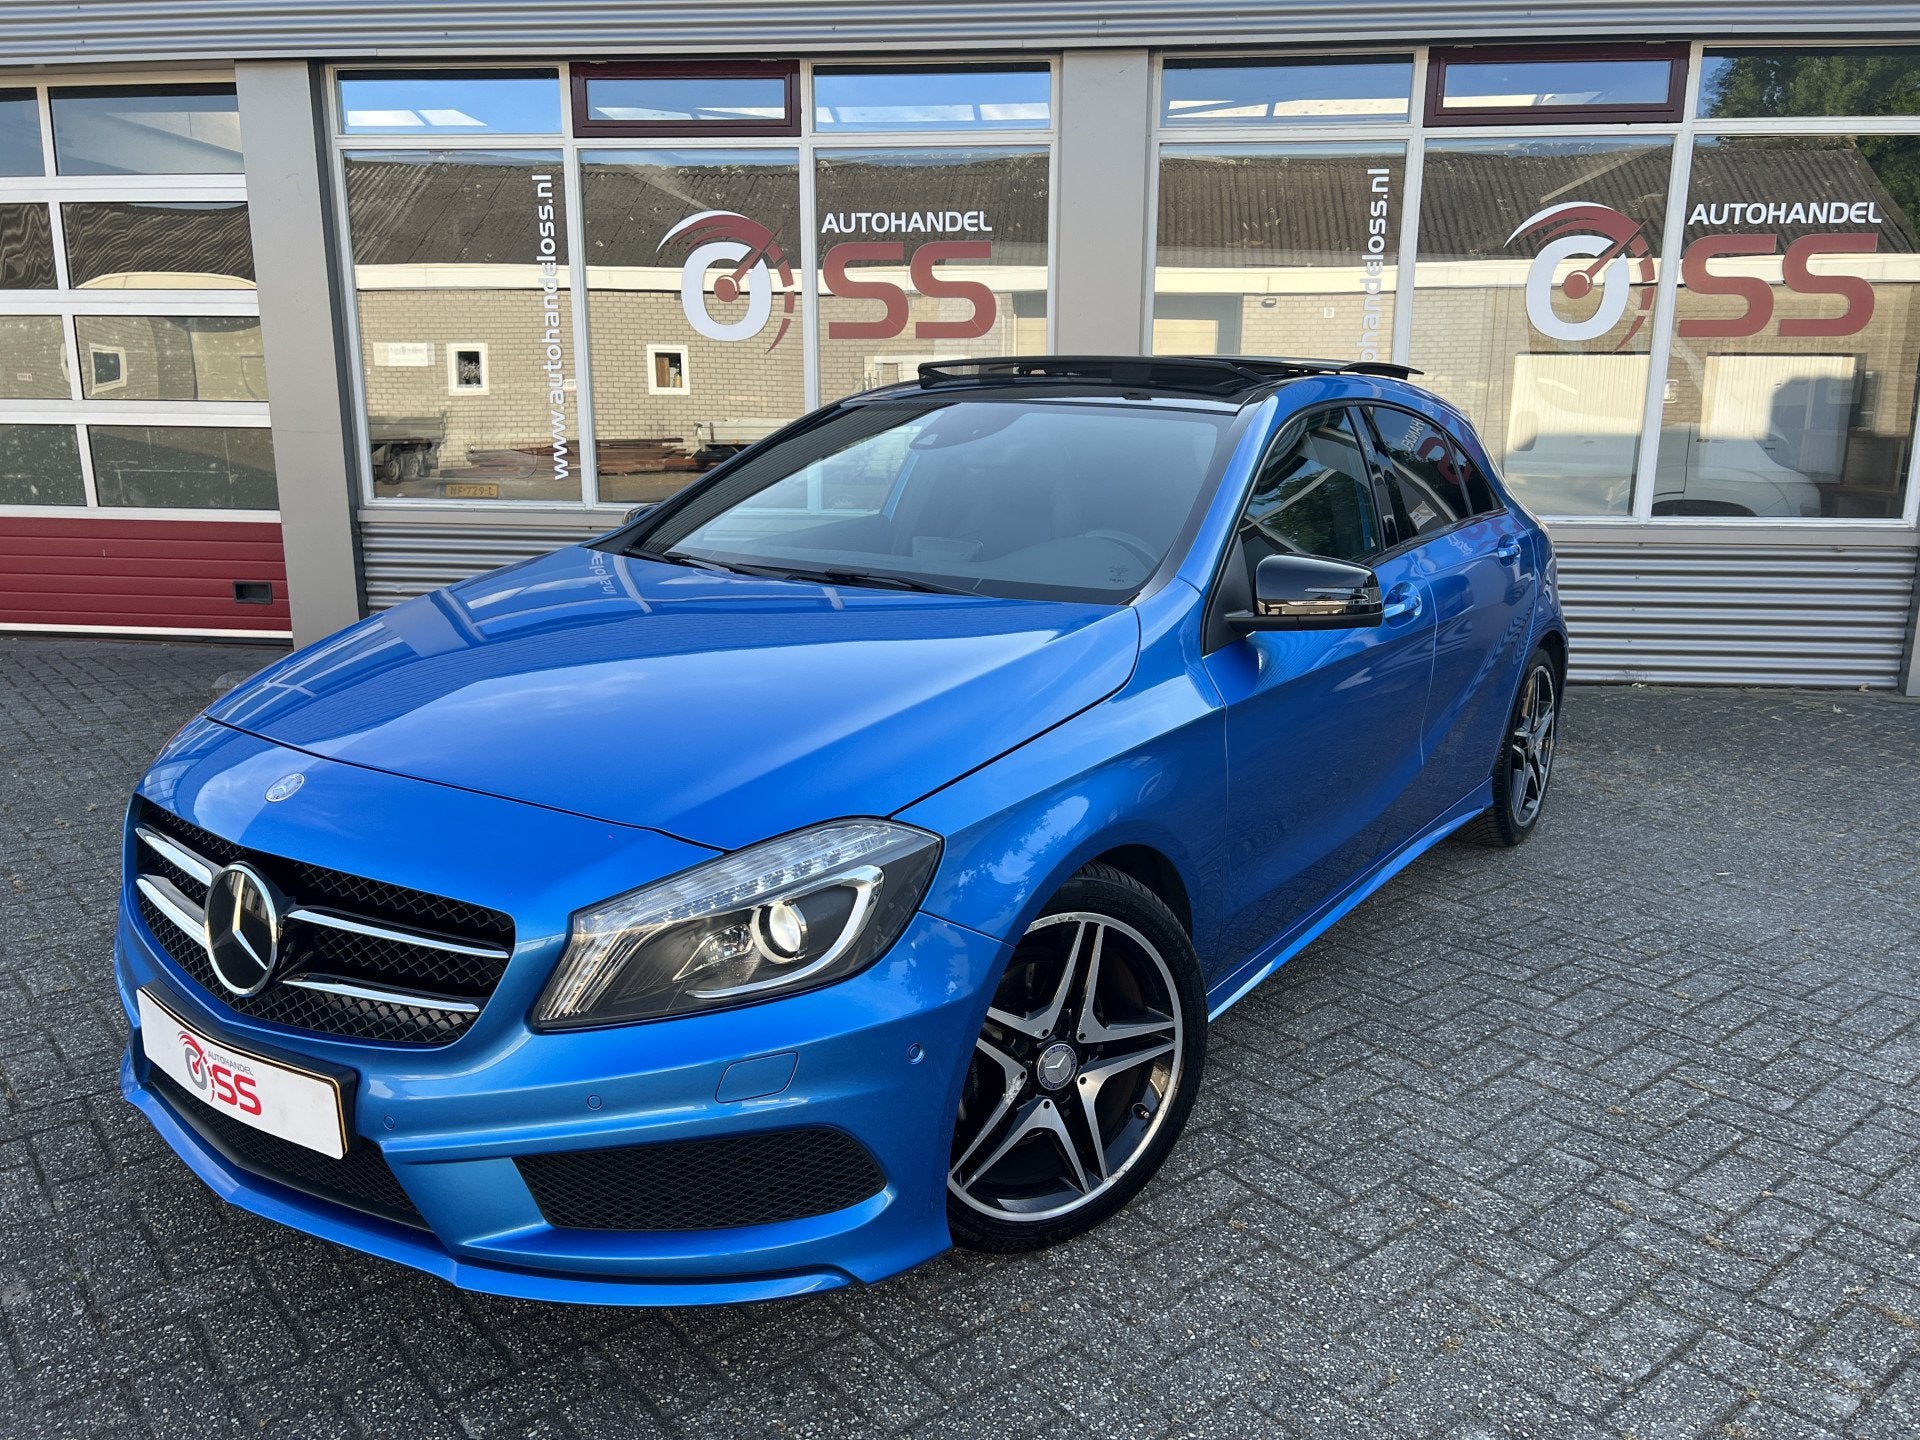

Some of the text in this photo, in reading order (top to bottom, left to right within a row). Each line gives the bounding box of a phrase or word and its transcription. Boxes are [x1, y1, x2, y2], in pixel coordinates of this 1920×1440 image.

[821, 210, 993, 234] AUTOHANDEL
[1687, 201, 1883, 225] AUTOHANDEL
[531, 174, 570, 480] www.autohandeloss.nl
[207, 1050, 254, 1076] AUTOHANDEL
